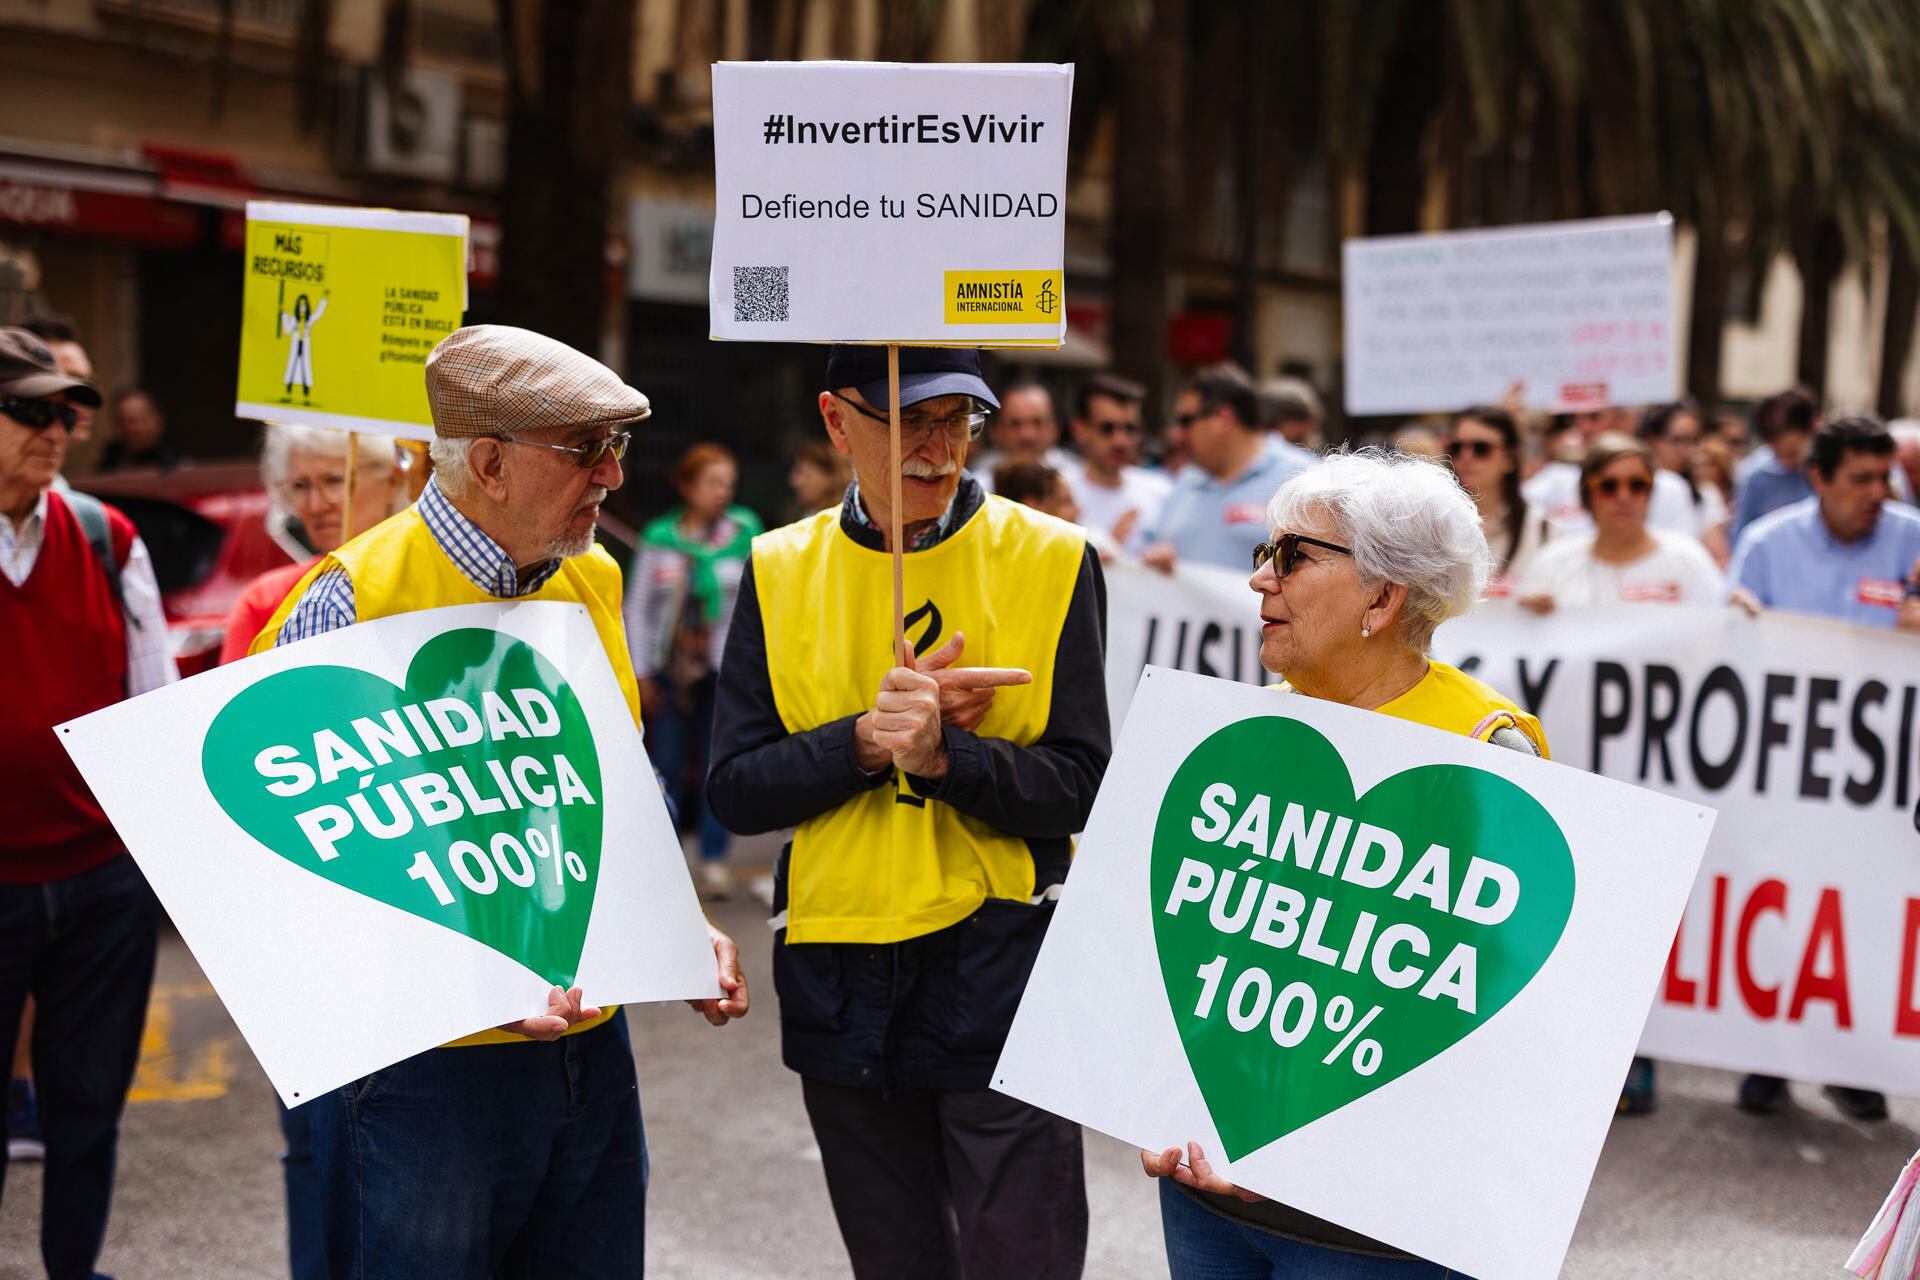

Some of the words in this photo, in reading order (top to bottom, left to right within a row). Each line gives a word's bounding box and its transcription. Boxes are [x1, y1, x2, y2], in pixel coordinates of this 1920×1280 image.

[763, 114, 1045, 145] #InvertirEsVivir
[741, 193, 870, 219] Defiende
[880, 193, 905, 219] tu
[916, 192, 1058, 219] SANIDAD
[274, 229, 303, 254] MÁS
[253, 256, 325, 282] RECURSOS
[384, 287, 396, 298] LA
[399, 288, 439, 302] SANIDAD
[956, 279, 1024, 299] AMNISTÍA
[956, 301, 1024, 313] INTERNACIONAL
[409, 317, 421, 329] EN
[253, 687, 561, 797] SANIDAD
[293, 754, 596, 863] PÚBLICA
[405, 823, 587, 906] 100%
[1191, 782, 1521, 926] SANIDAD
[1164, 857, 1477, 1015] PÚBLICA
[1663, 873, 1853, 1030] LICA
[1193, 954, 1385, 1076] 100%
